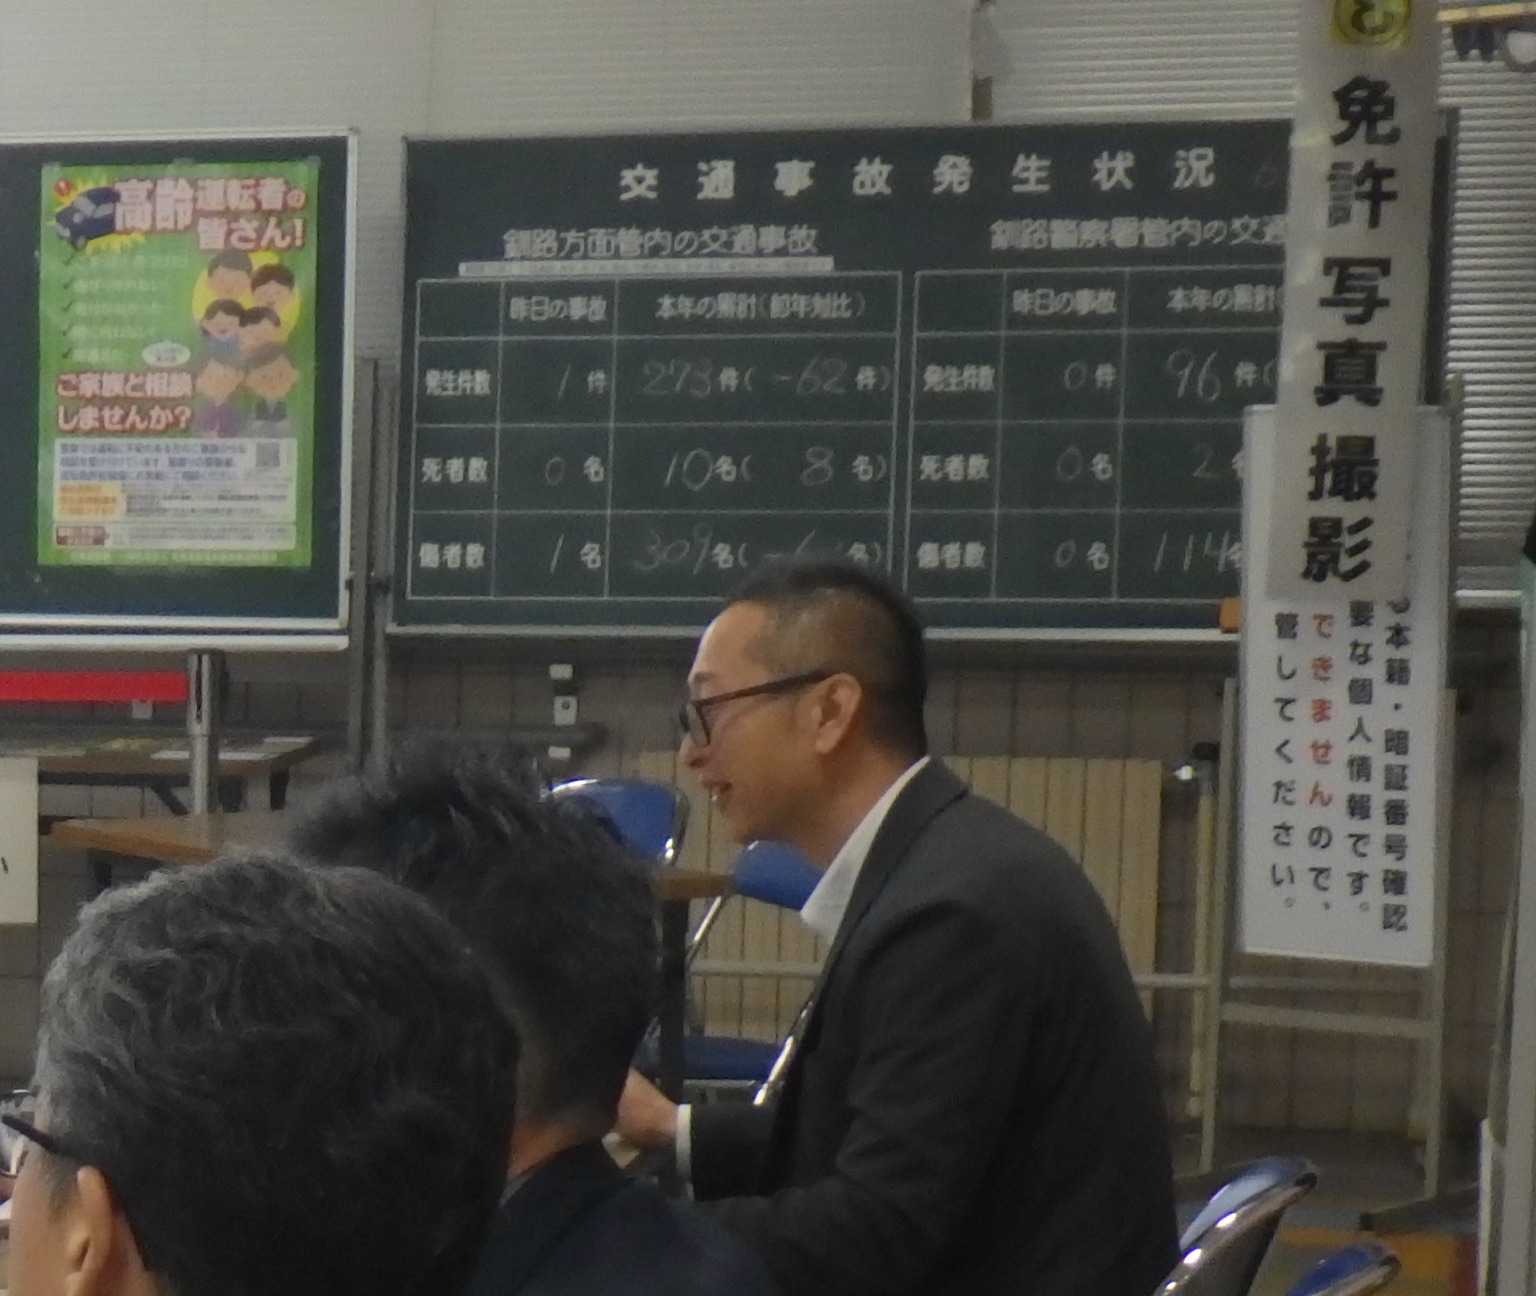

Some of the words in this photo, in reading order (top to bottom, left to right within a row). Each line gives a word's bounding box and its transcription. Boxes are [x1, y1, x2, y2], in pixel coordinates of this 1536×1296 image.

[619, 147, 1216, 201] 交通事故発生状況
[502, 223, 819, 260] 釧路方面管内の交通事故
[509, 295, 608, 321] 昨日の事故
[1012, 288, 1117, 315] 昨日の事故
[1301, 74, 1401, 582] 免許写真撮影
[57, 372, 193, 398] ご家族と相談
[57, 404, 192, 431] しませんか?
[420, 455, 488, 483] 死者数
[920, 453, 990, 482] 死者数
